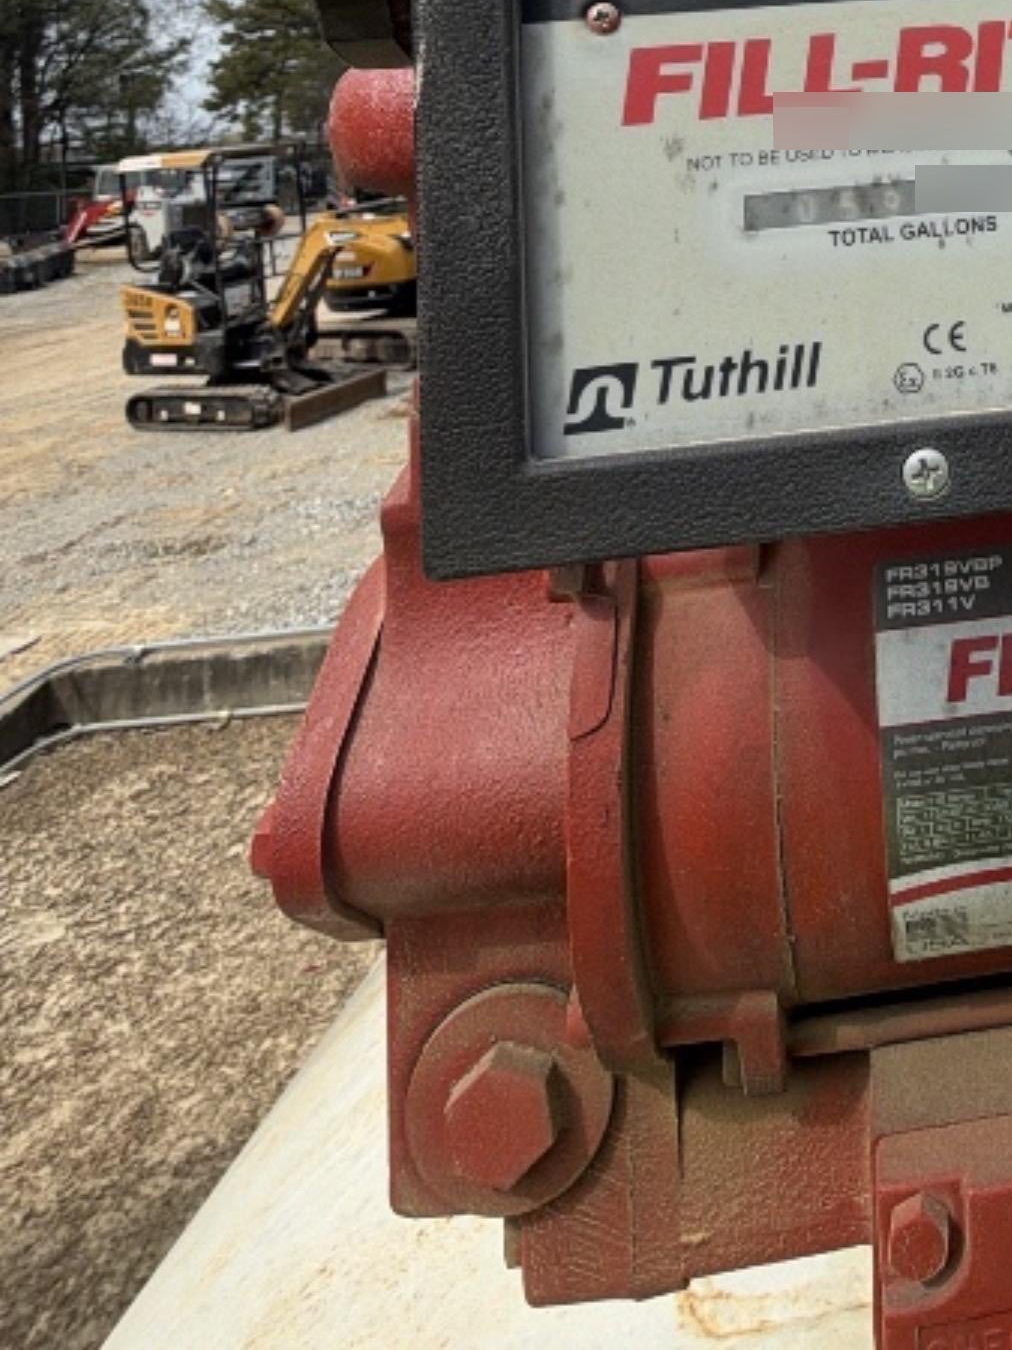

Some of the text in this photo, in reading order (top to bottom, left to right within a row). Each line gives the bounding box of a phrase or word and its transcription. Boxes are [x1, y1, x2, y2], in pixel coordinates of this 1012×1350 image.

[827, 215, 998, 248] TOTAL GALLONS
[651, 341, 822, 405] Tuthill
